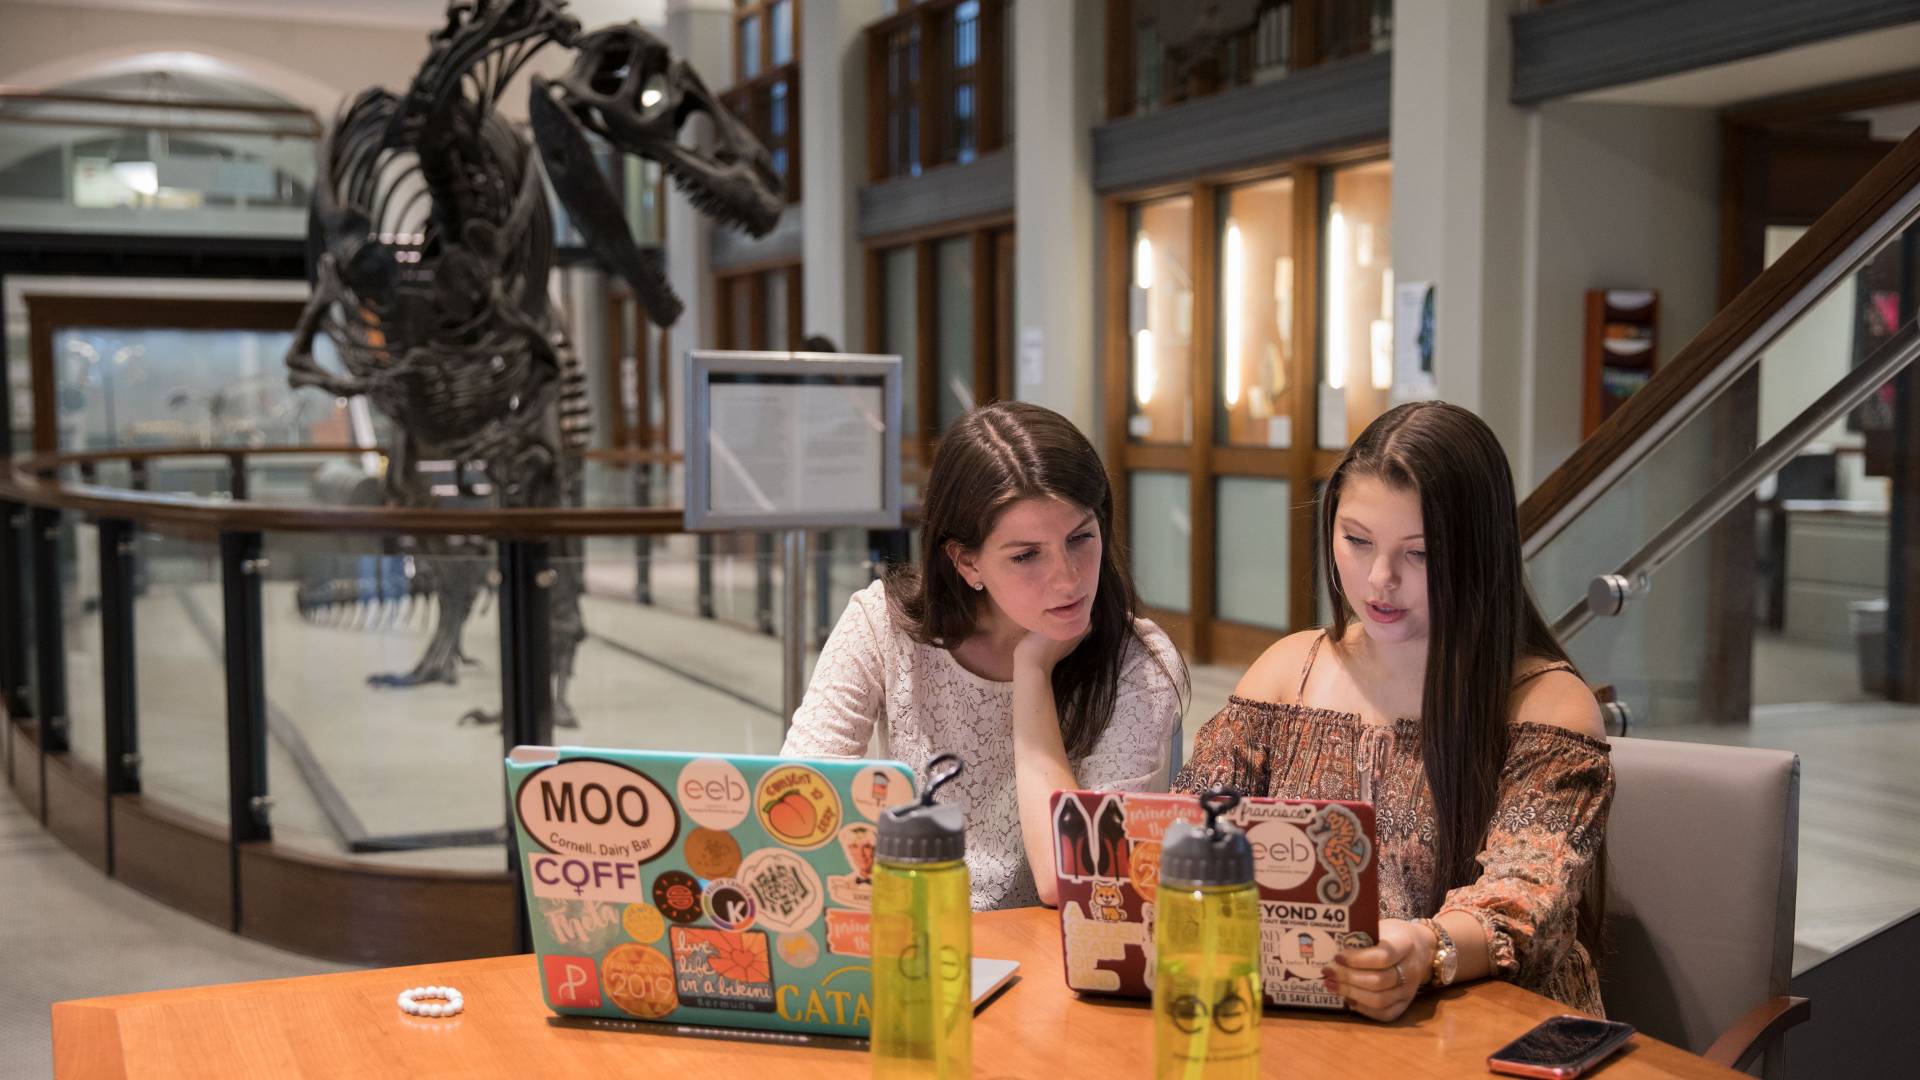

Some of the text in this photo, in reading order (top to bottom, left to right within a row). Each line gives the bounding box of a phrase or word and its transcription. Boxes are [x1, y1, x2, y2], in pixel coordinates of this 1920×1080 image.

[684, 773, 745, 801] eeb
[540, 780, 649, 827] MOO
[600, 843, 631, 858] Dairy
[632, 837, 653, 852] Bar
[1252, 836, 1310, 862] eeb
[726, 900, 746, 925] K
[1256, 904, 1346, 923] YOND 40
[610, 972, 674, 1001] 2019
[681, 976, 771, 1000] in a bikini
[1276, 993, 1340, 1005] TO SAVE LIVES
